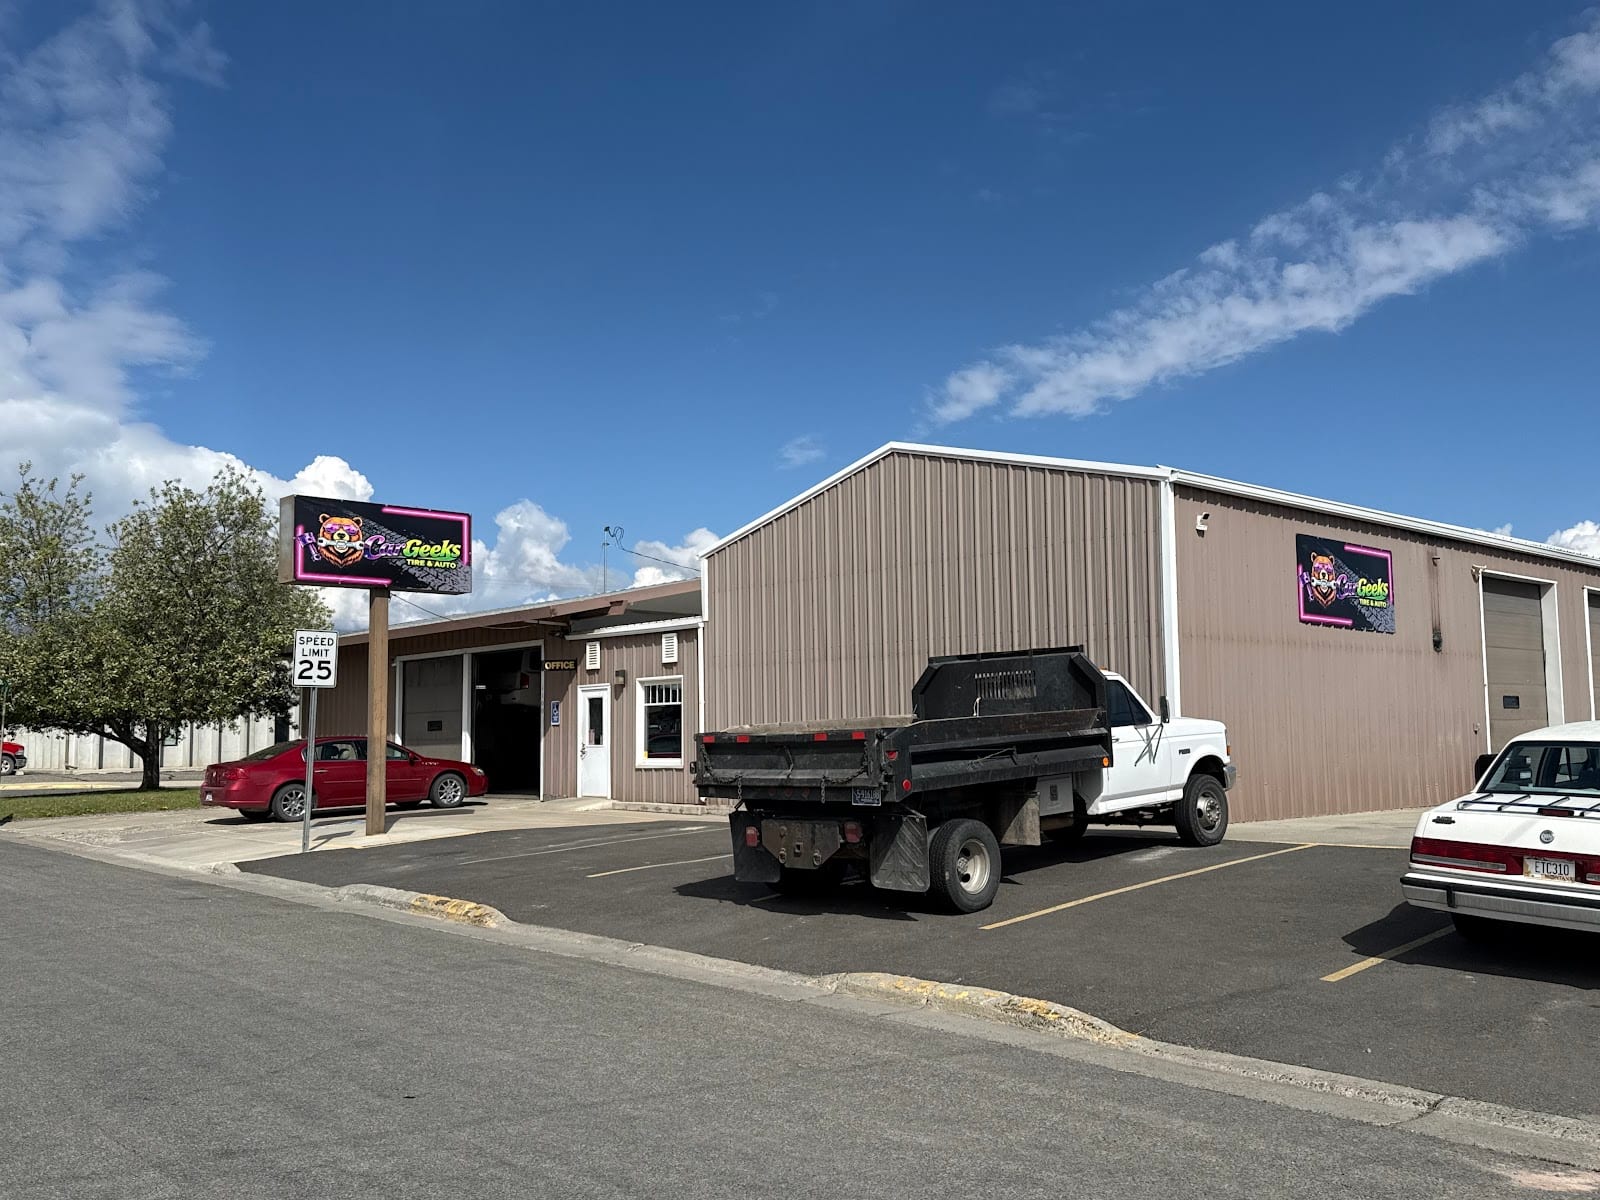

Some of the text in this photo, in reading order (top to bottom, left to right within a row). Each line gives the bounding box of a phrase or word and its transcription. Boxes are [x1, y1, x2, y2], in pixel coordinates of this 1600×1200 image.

[406, 558, 457, 569] TIRE & AUTO
[298, 636, 334, 646] SPEED
[301, 648, 330, 657] LIMIT
[297, 659, 332, 680] 25
[544, 661, 575, 670] OFFICE
[1534, 861, 1570, 876] ETC310
